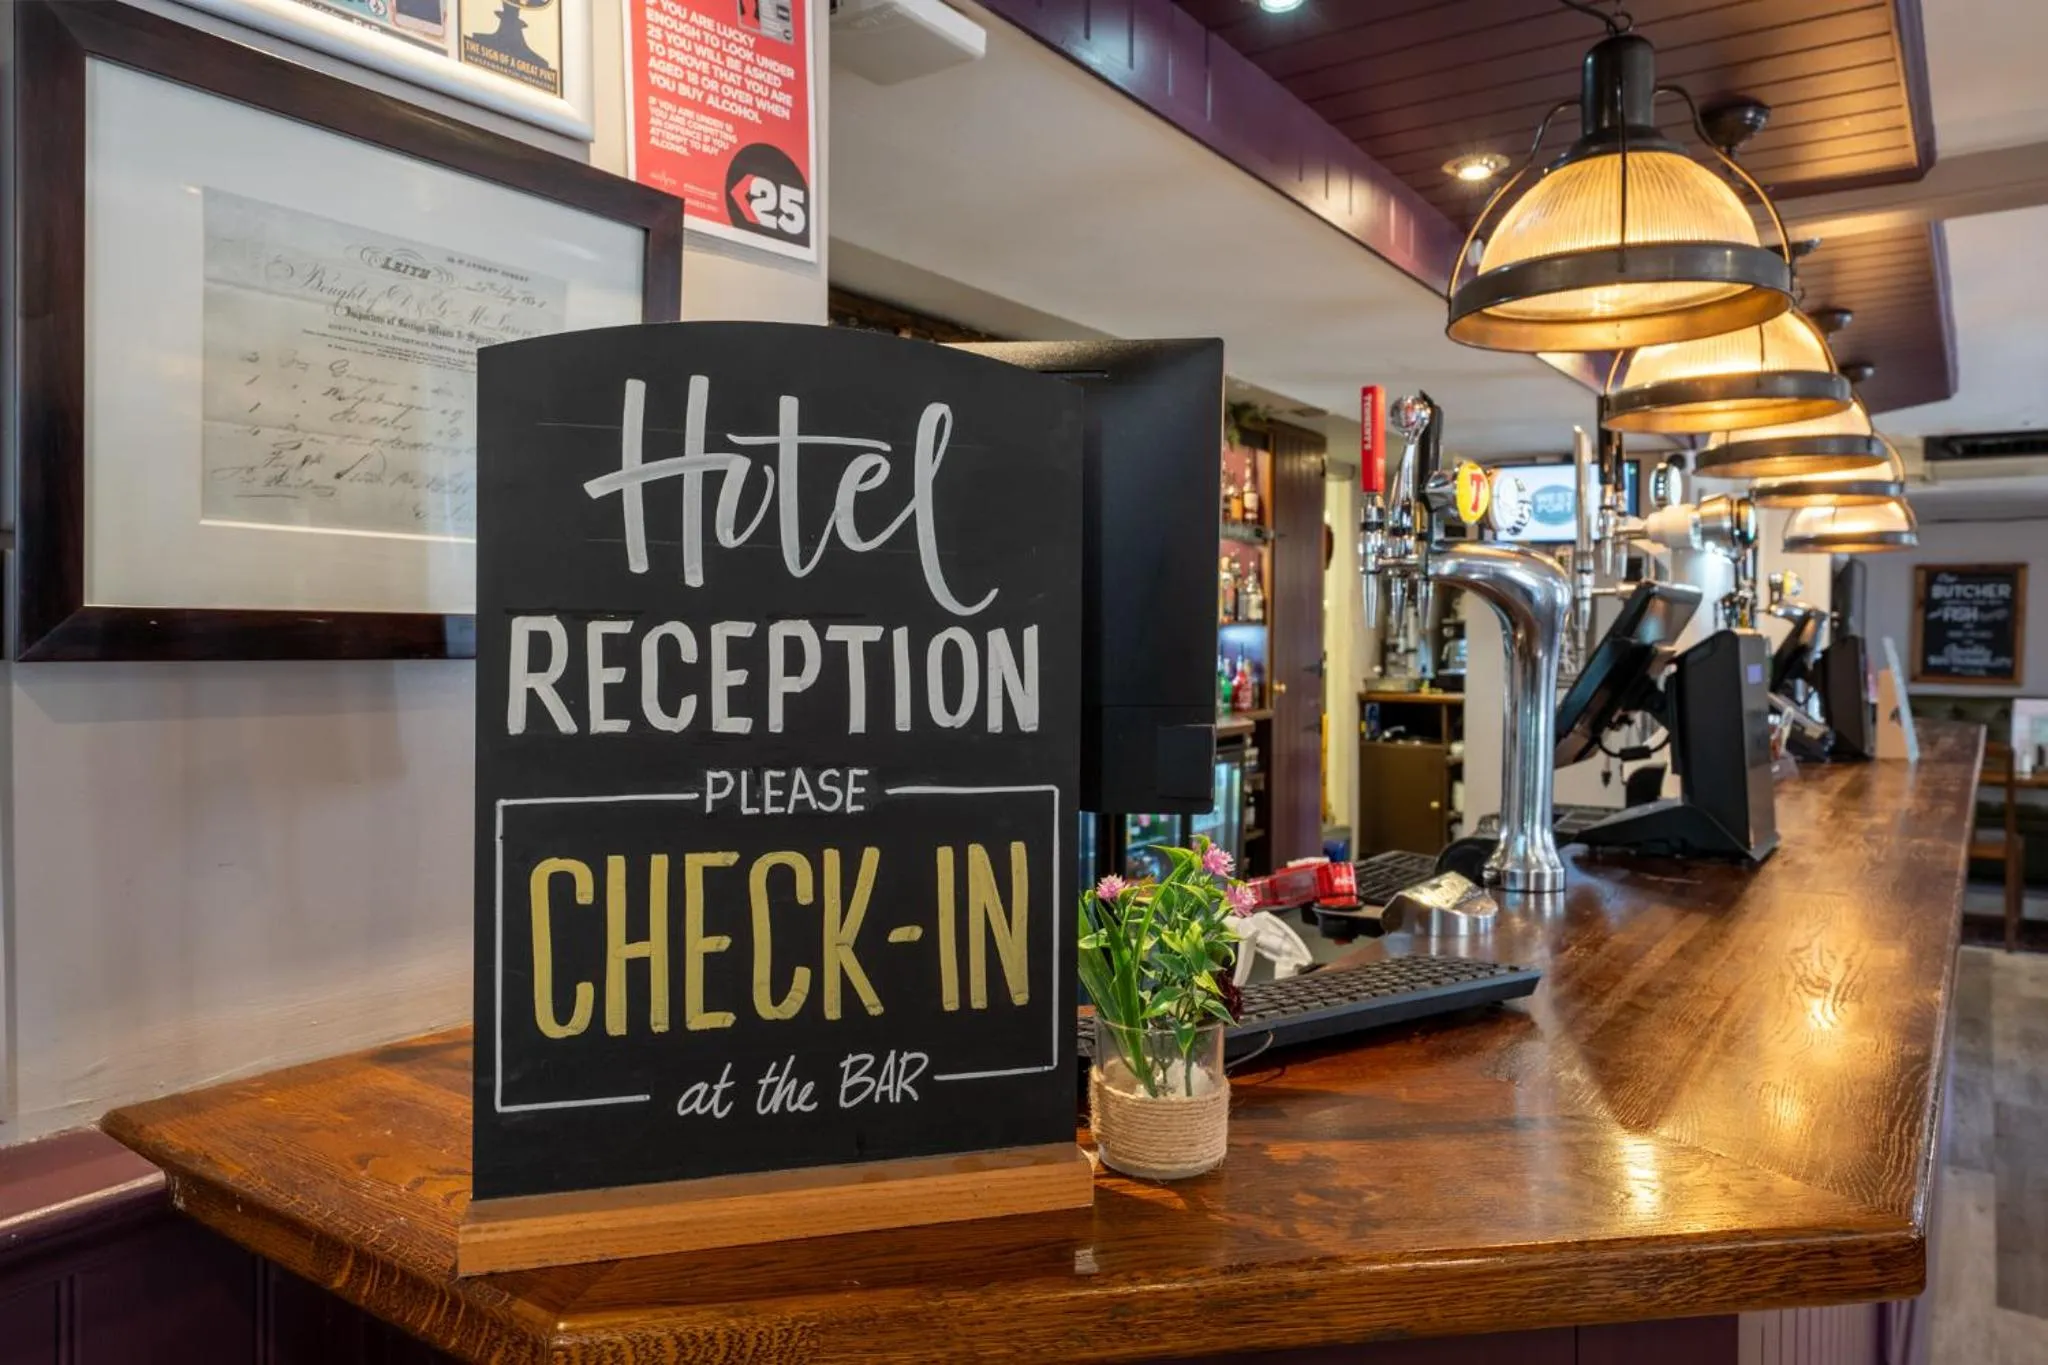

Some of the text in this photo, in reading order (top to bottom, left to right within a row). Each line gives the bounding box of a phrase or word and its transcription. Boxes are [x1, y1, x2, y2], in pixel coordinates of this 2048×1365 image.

[646, 6, 795, 80] ENOUGH TO LOOK UNDER
[646, 23, 782, 88] 25 YOU WILL BE ASKED
[660, 0, 757, 48] YOU ARE LUCKY
[647, 38, 793, 108] TO PROVE THAT YOU ARE
[649, 71, 676, 92] YOU
[678, 82, 704, 102] BUY
[649, 56, 790, 120] AGED 18 OR OVER WHEN
[381, 257, 432, 280] LEITH
[583, 374, 999, 617] Hotel
[1931, 583, 2012, 599] BUTCHER
[507, 614, 1040, 735] RECEPTION
[704, 768, 870, 815] PLEASE
[529, 840, 1030, 1040] CHECK-IN
[676, 1050, 930, 1119] at the BAR
